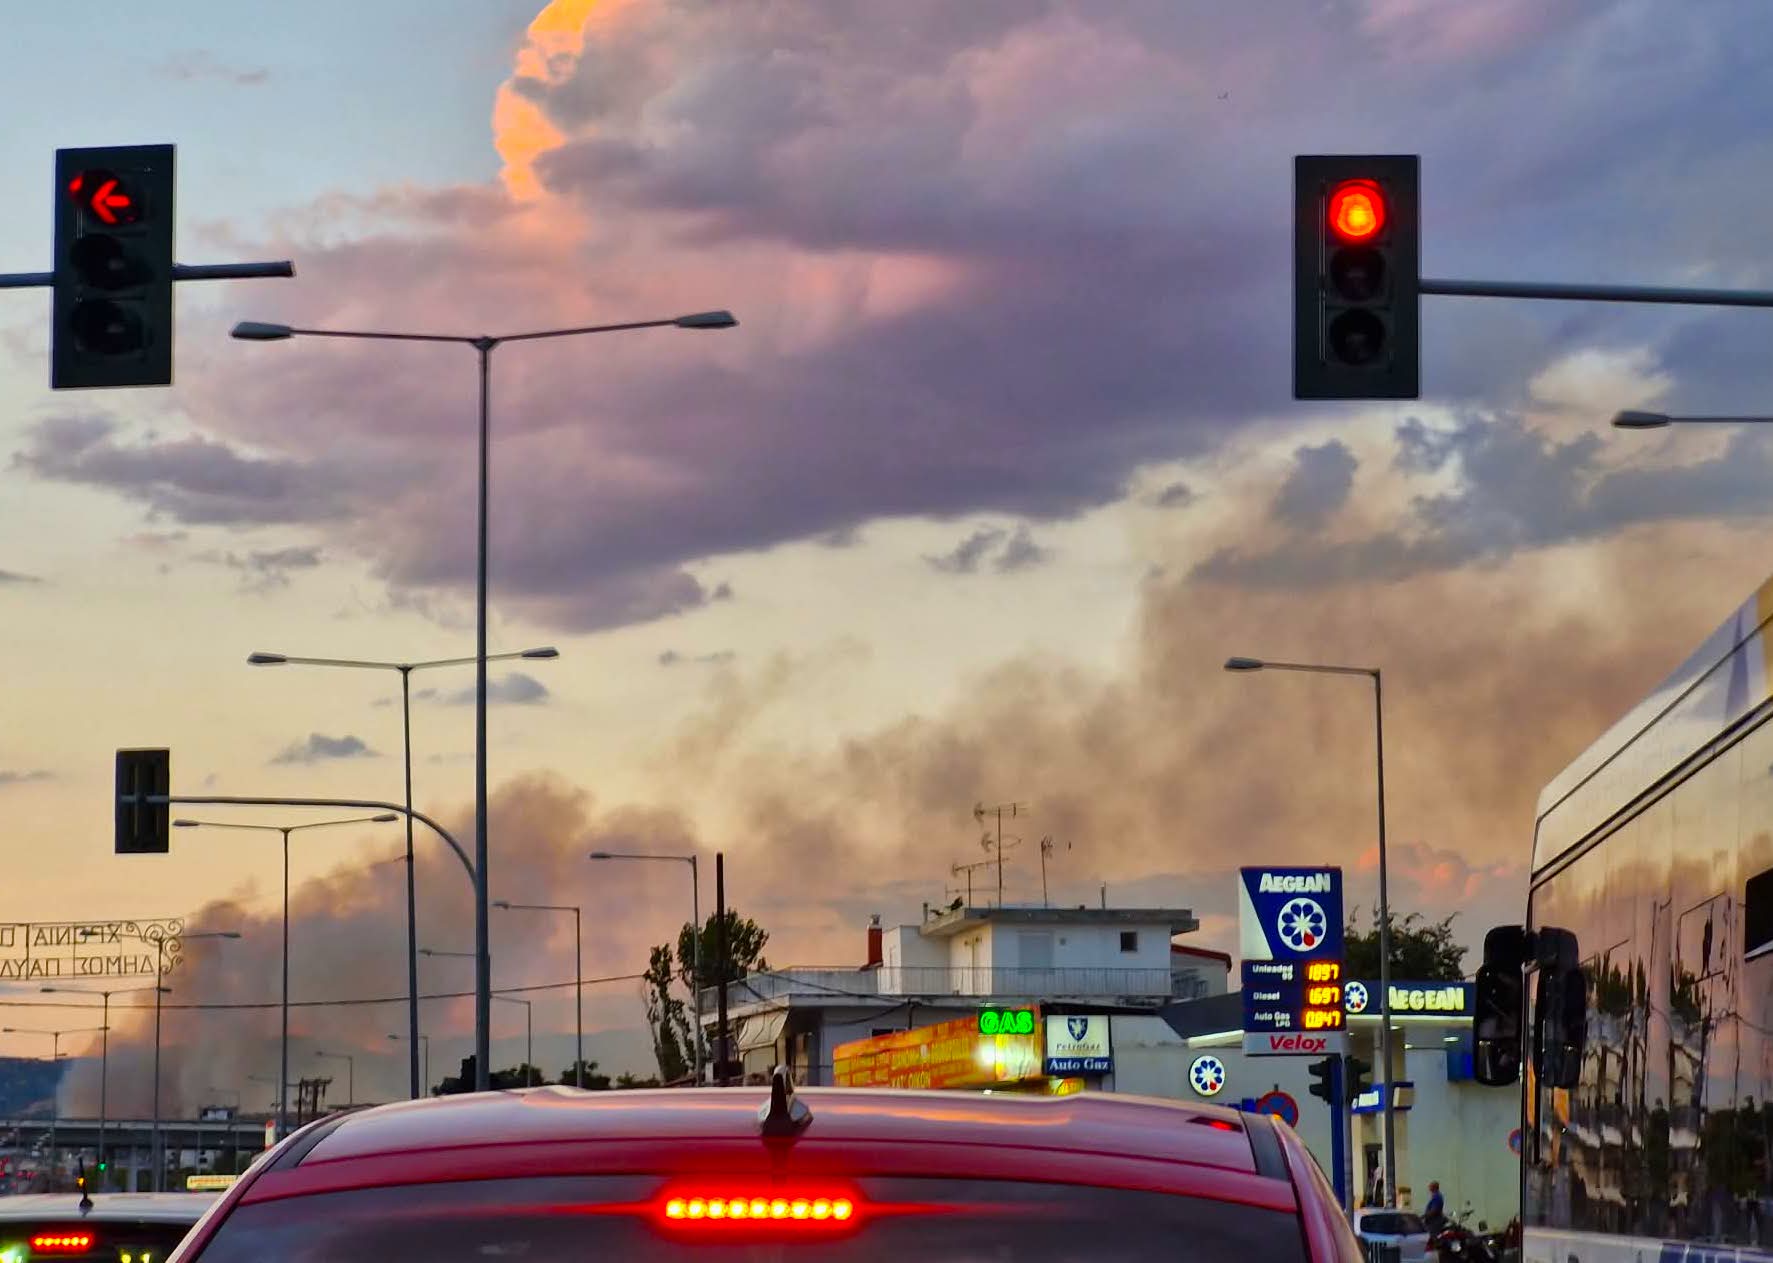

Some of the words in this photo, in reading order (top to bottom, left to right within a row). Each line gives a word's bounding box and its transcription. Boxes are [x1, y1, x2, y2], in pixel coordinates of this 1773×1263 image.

[1259, 873, 1330, 893] AEGEAN
[1252, 964, 1293, 974] Unleaded
[1253, 991, 1280, 1001] Diesel
[1388, 986, 1465, 1011] AEGEAN
[980, 1011, 1033, 1035] GAS
[1254, 1012, 1273, 1021] Auto
[1274, 1011, 1290, 1020] Gas
[1270, 1034, 1326, 1052] Velox
[1050, 1058, 1080, 1072] Auto
[1083, 1058, 1108, 1071] Gaz
